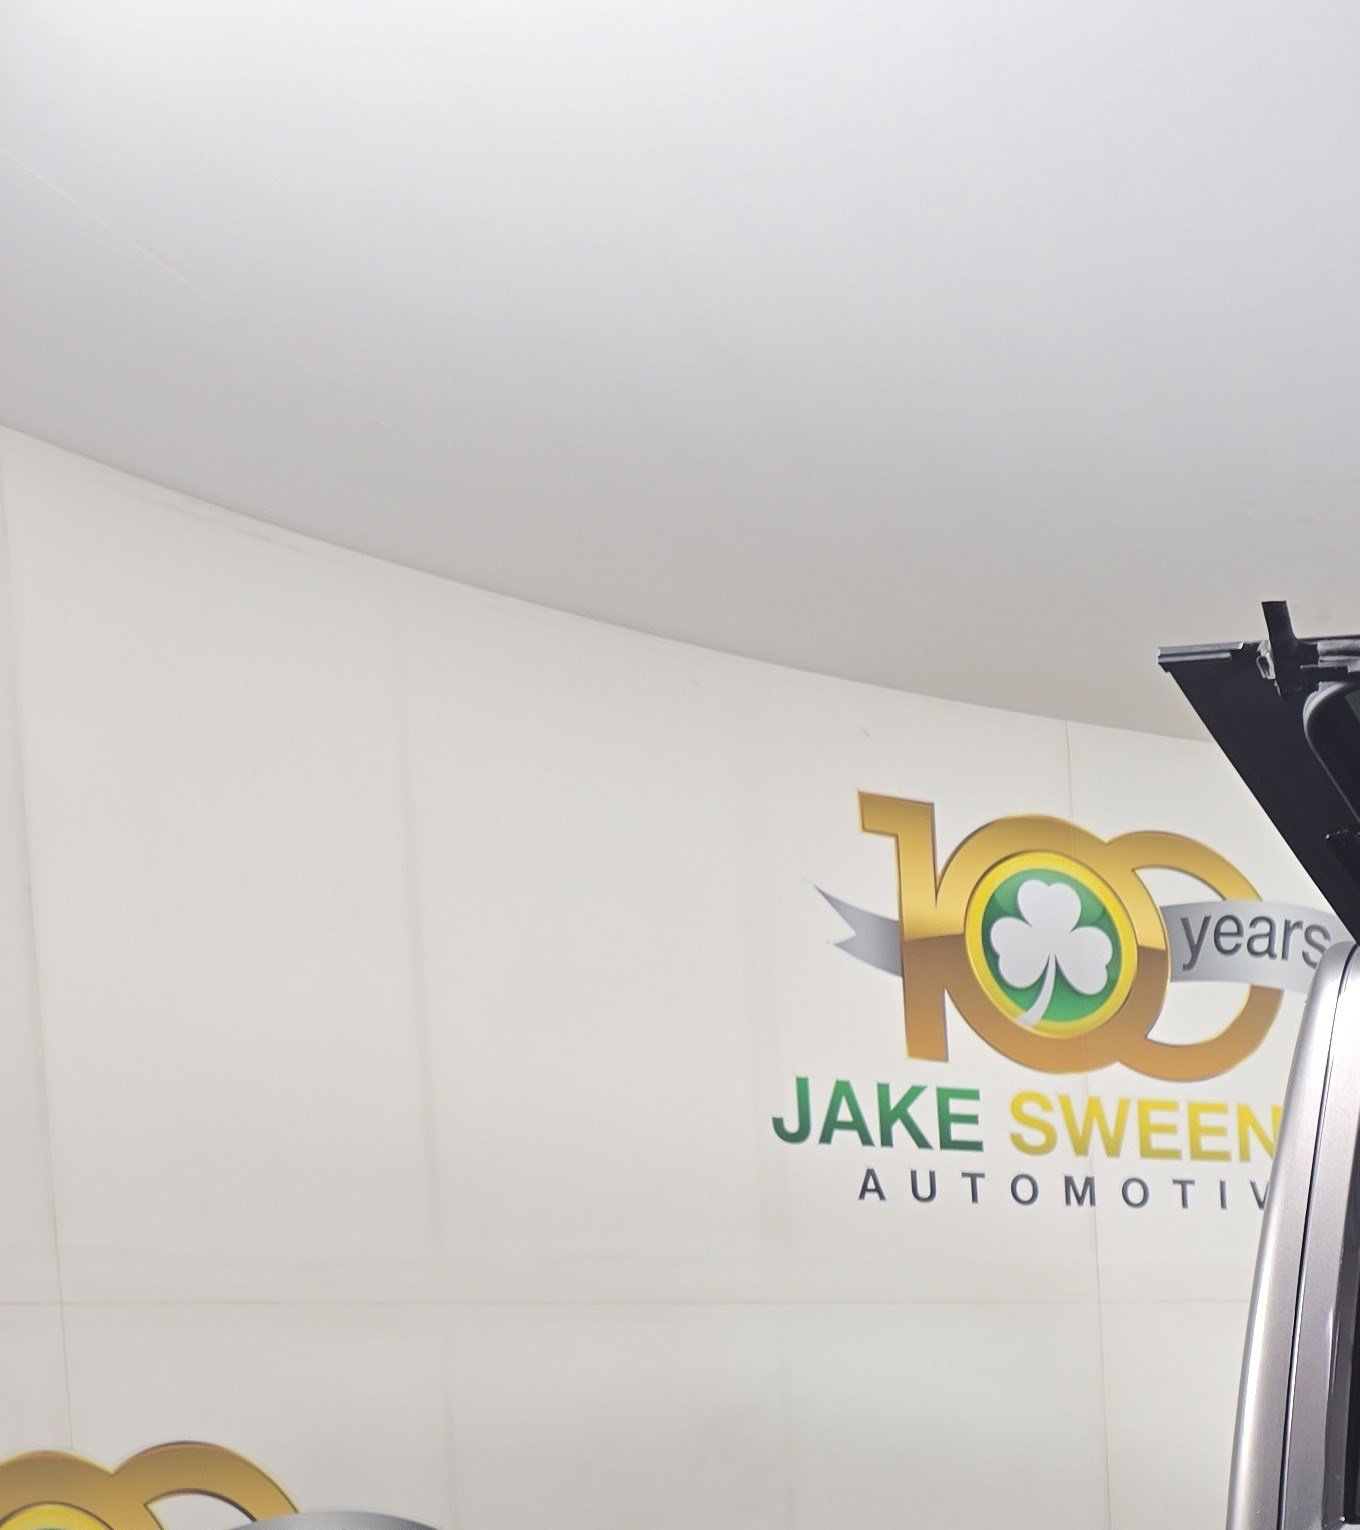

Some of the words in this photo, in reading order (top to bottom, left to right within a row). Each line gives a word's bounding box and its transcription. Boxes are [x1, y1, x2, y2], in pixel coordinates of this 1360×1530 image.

[1180, 914, 1331, 971] years
[772, 1076, 983, 1153] JAKE
[1010, 1091, 1283, 1162] SWEEN
[859, 1168, 1268, 1210] AUTOMOTIV
